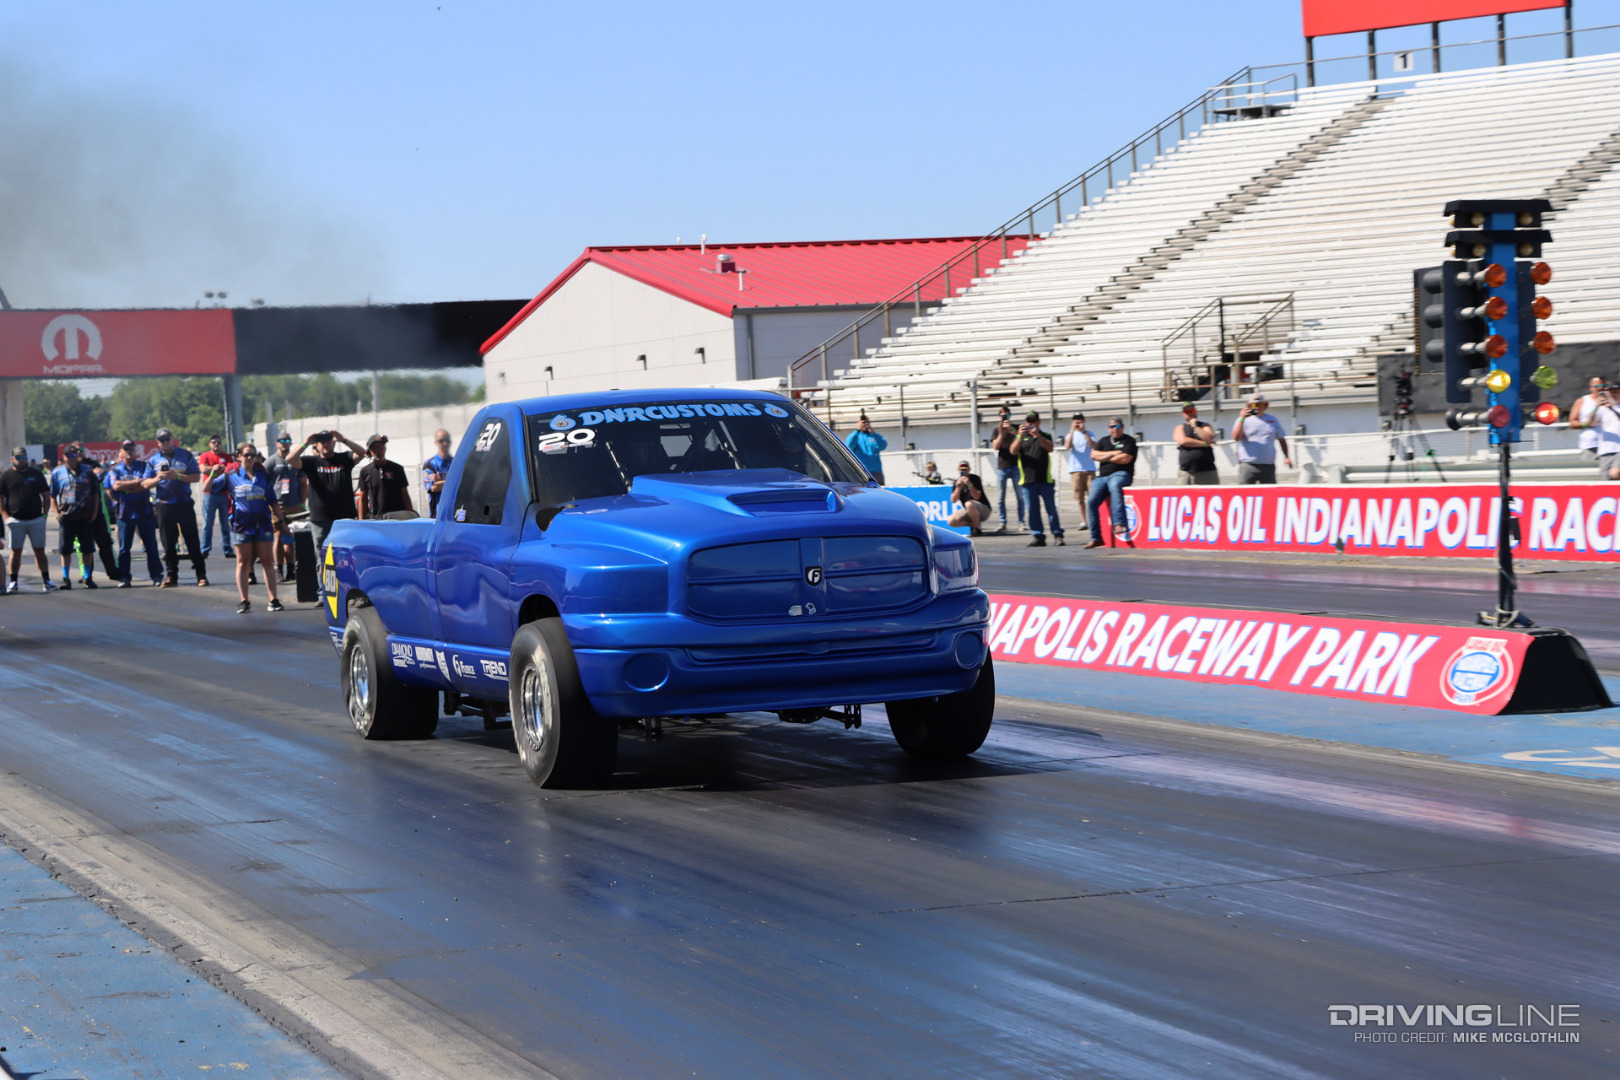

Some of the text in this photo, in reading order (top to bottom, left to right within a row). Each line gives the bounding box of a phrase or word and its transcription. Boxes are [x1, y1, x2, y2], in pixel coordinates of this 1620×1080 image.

[1400, 53, 1408, 69] 1
[578, 403, 762, 424] DNRCUSTOMS
[480, 422, 502, 449] 20
[539, 428, 596, 451] 20
[1148, 495, 1222, 543] LUCAS
[1226, 495, 1266, 543] OIL
[1528, 496, 1620, 553] RAC
[1105, 611, 1313, 682] RACEWAY
[1289, 626, 1442, 698] PARK
[480, 659, 508, 677] TREND
